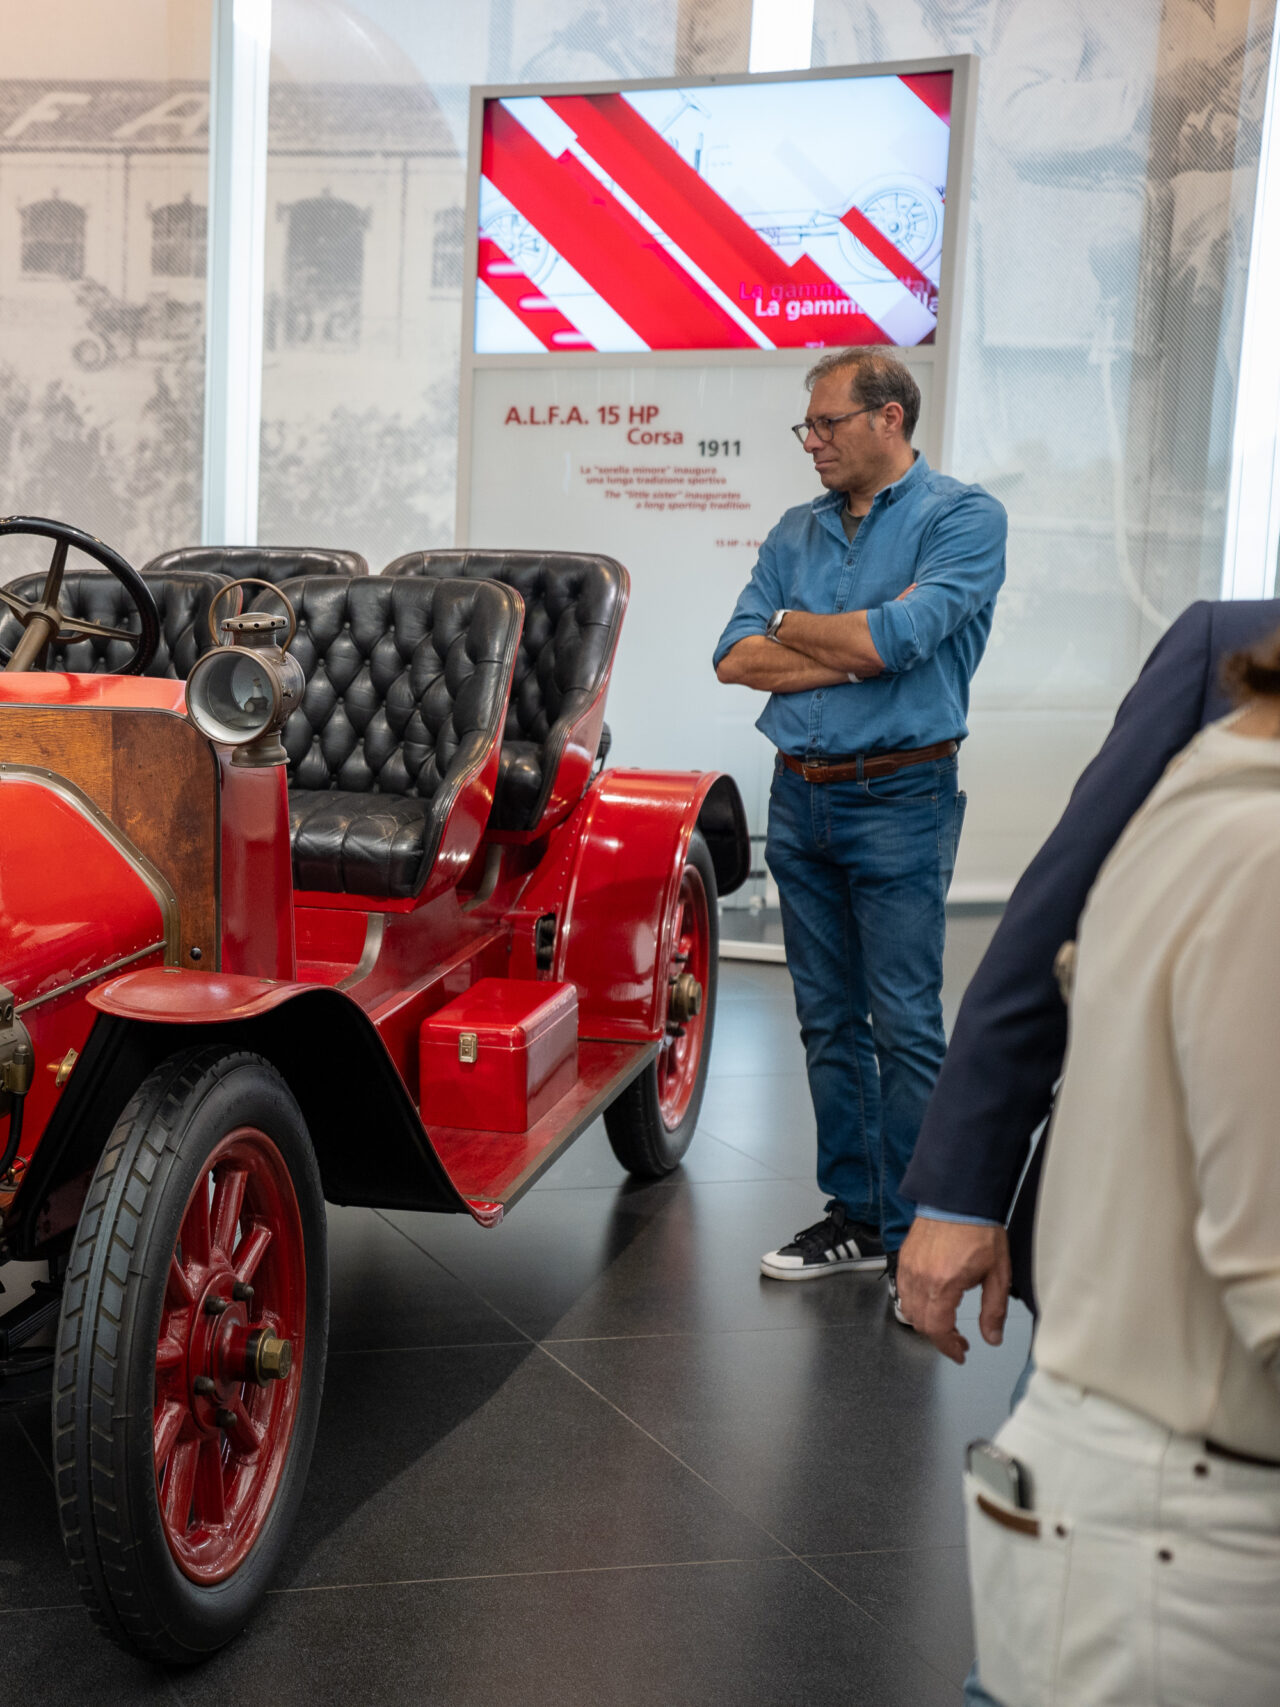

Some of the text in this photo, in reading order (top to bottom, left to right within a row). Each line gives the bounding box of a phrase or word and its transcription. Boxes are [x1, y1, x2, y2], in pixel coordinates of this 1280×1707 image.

[770, 283, 848, 303] gamm
[755, 297, 780, 317] La
[505, 405, 659, 425] A.L.F.A. 15 HP
[627, 427, 684, 445] Corsa
[698, 440, 742, 457] 1911
